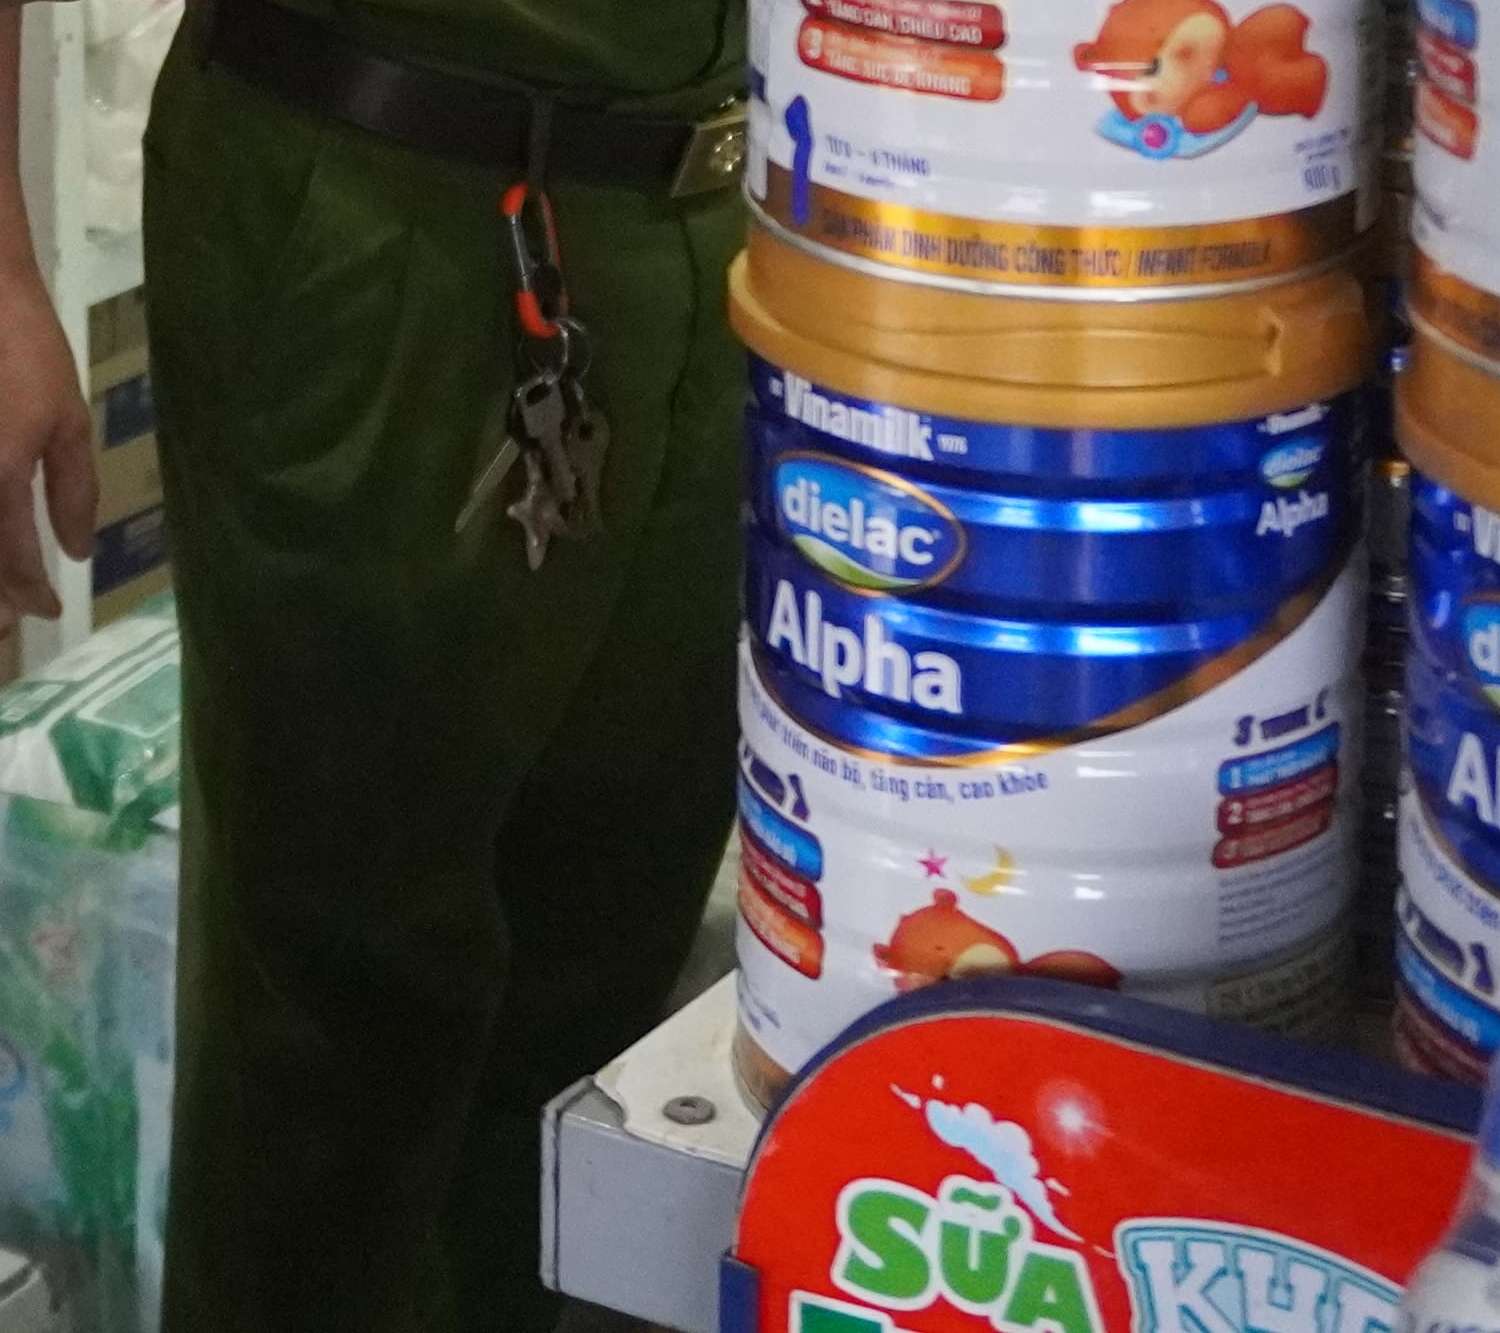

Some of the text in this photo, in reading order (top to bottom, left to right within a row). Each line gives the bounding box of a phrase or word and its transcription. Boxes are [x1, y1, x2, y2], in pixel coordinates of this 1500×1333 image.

[784, 95, 812, 224] 1
[780, 370, 934, 461] Vinamilk
[783, 476, 938, 566] dielac
[1255, 489, 1330, 538] Alpha
[765, 579, 964, 715] Alpha
[840, 1180, 1096, 1333] SỮA
